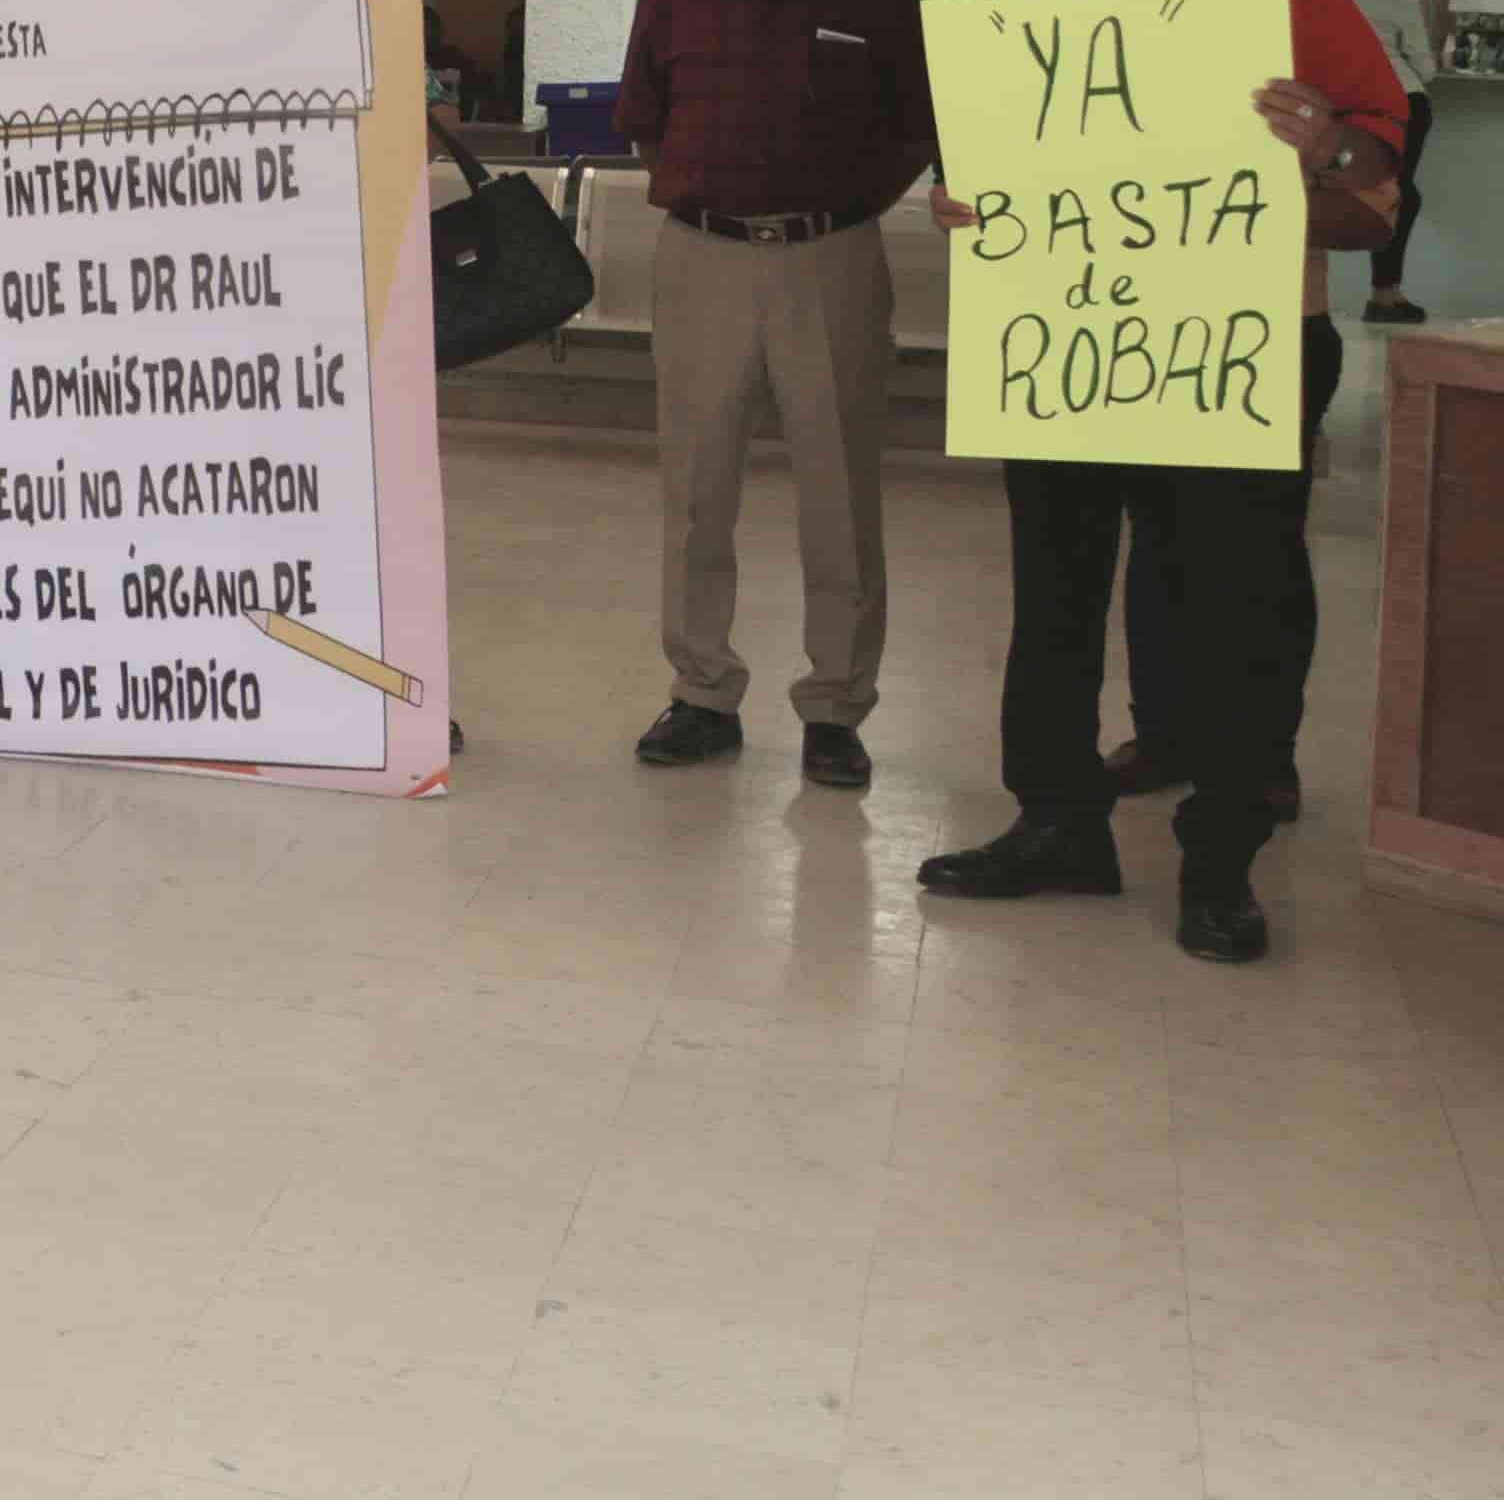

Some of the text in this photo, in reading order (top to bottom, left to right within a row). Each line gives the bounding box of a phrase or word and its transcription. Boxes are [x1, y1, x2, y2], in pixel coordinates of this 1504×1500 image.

[255, 144, 300, 203] DE
[972, 169, 1268, 261] BASTA
[2, 261, 65, 325] QUE
[78, 259, 117, 315] EL
[130, 254, 176, 313] DR
[191, 252, 282, 311] RAUL
[1066, 262, 1139, 309] de
[1001, 309, 1271, 426] ROBAR
[80, 469, 123, 520] NO
[138, 456, 319, 518] ACATARON
[34, 566, 97, 622] DEL
[273, 559, 317, 616] DE
[24, 670, 45, 720] Y
[59, 665, 101, 721] DE
